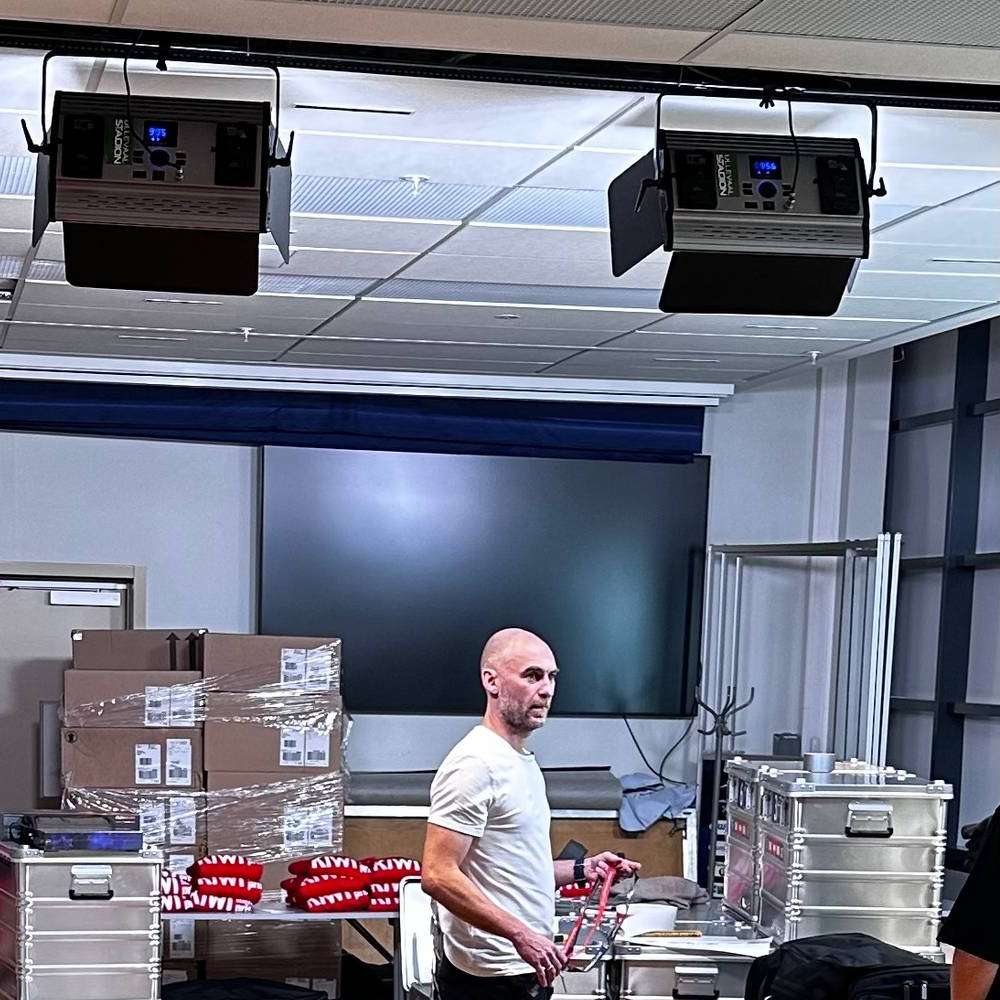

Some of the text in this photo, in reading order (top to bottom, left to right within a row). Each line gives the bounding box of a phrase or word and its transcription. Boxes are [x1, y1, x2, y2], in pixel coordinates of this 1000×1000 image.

[114, 119, 123, 165] STADION
[716, 154, 728, 196] STADION
[310, 855, 358, 870] KIWI
[372, 858, 421, 872] KIWI
